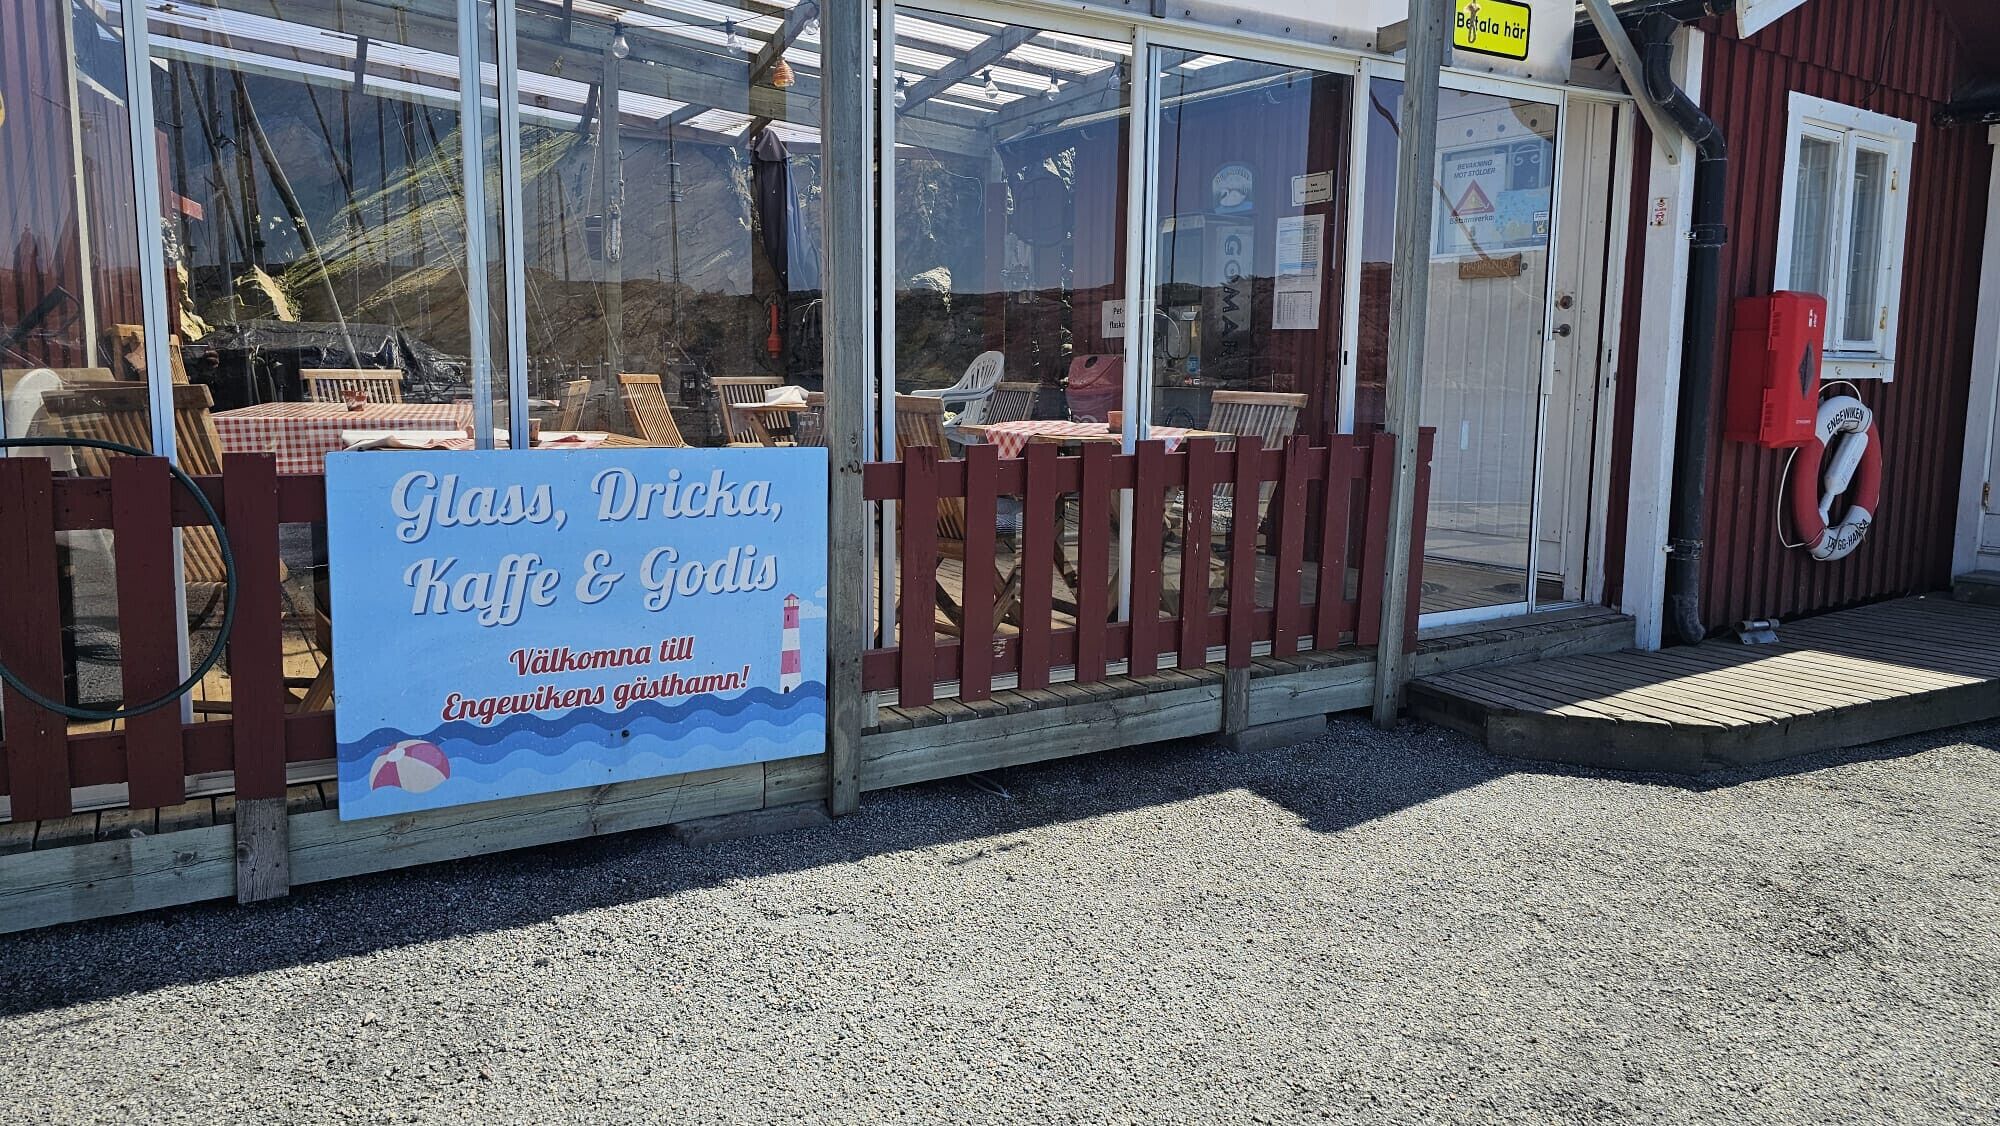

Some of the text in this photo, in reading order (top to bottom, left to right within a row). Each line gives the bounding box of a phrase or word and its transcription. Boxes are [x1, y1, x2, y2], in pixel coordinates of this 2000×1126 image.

[1456, 12, 1526, 40] Betala här
[1454, 171, 1467, 179] MOT
[1457, 159, 1493, 170] BEVAKNING
[1826, 407, 1865, 434] ENGEWIKEN
[391, 467, 782, 543] Glass, Dricka,
[403, 544, 778, 627] Kaffe & Godis
[509, 635, 694, 676] Välkomna till
[442, 665, 751, 725] Engewikens gästhamn!
